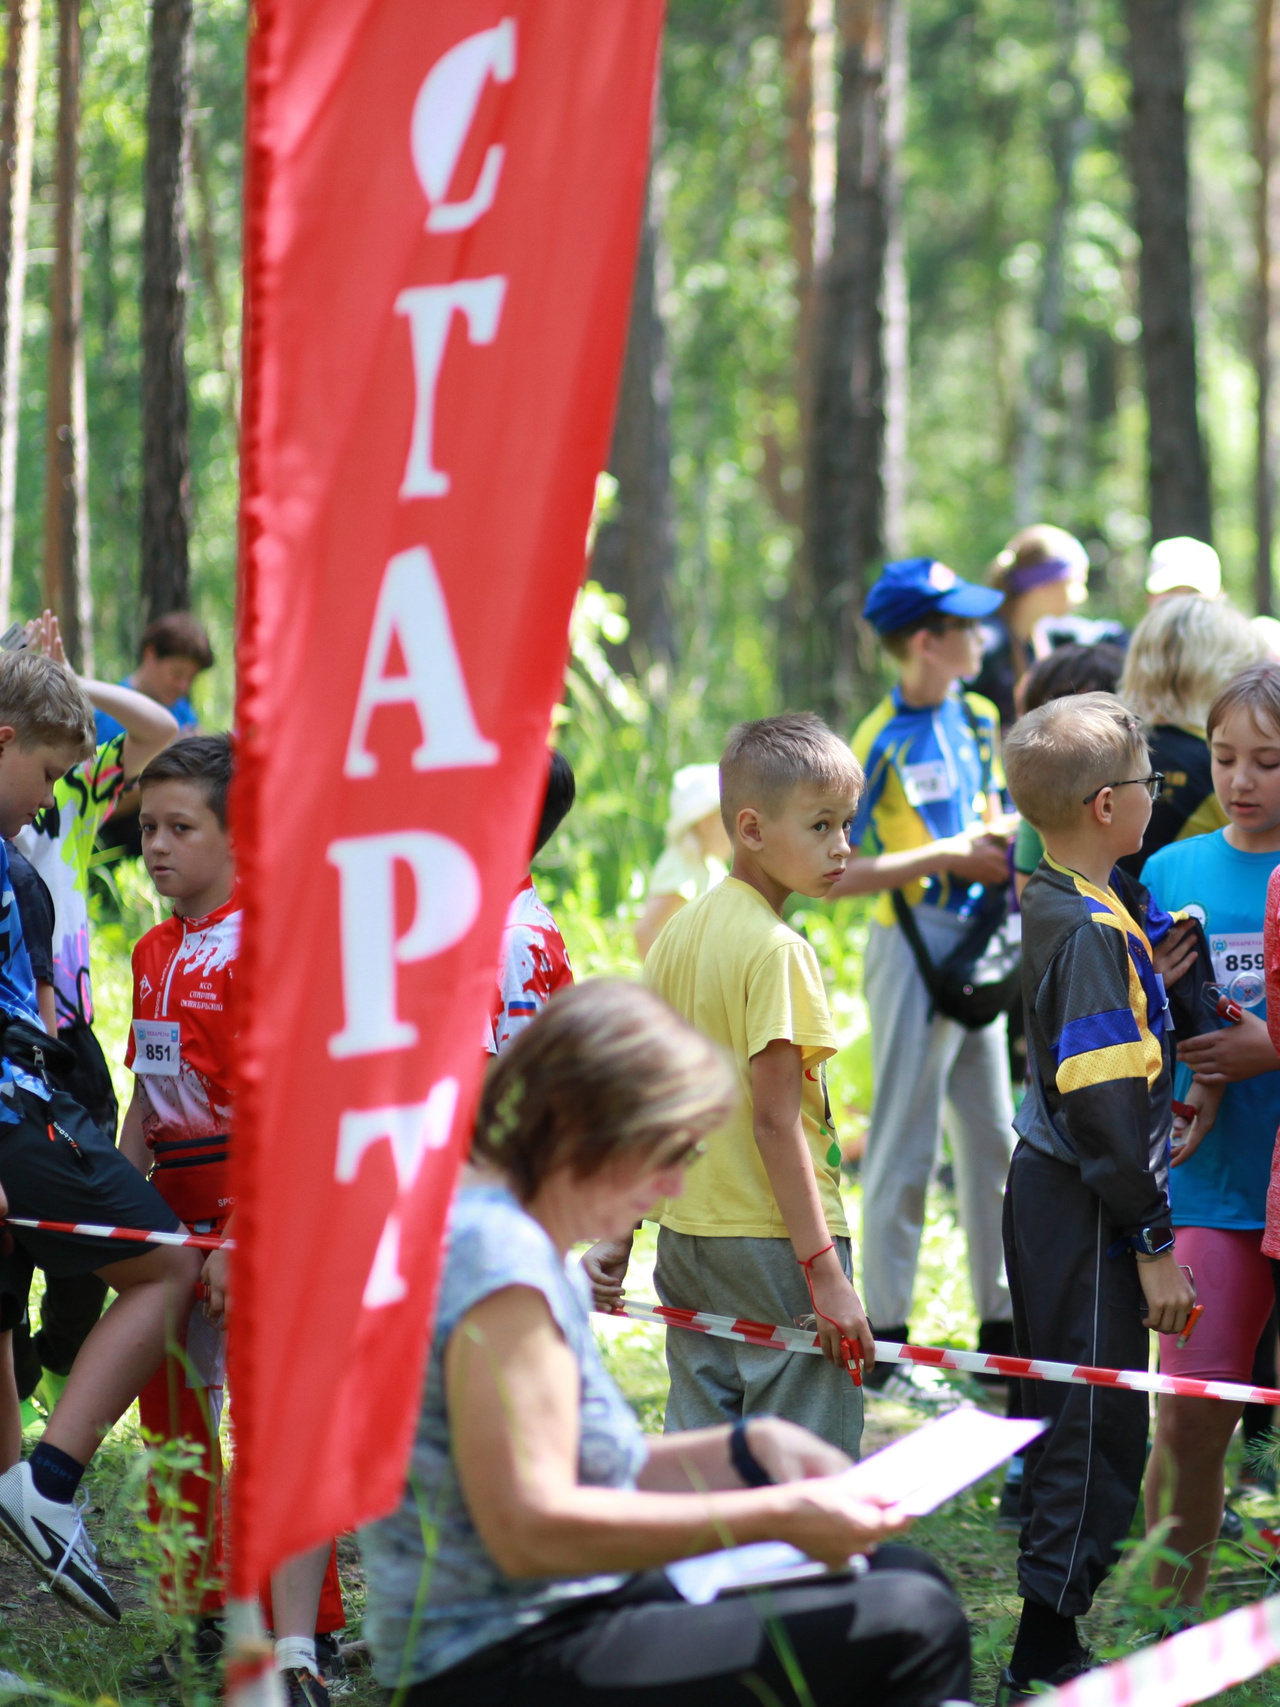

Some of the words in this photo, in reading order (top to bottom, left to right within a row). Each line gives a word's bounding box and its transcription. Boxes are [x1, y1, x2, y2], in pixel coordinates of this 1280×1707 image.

[328, 18, 516, 1310] СТАРТ
[1225, 953, 1265, 972] 859
[145, 1043, 171, 1062] 851
[217, 1196, 236, 1207] SPO
